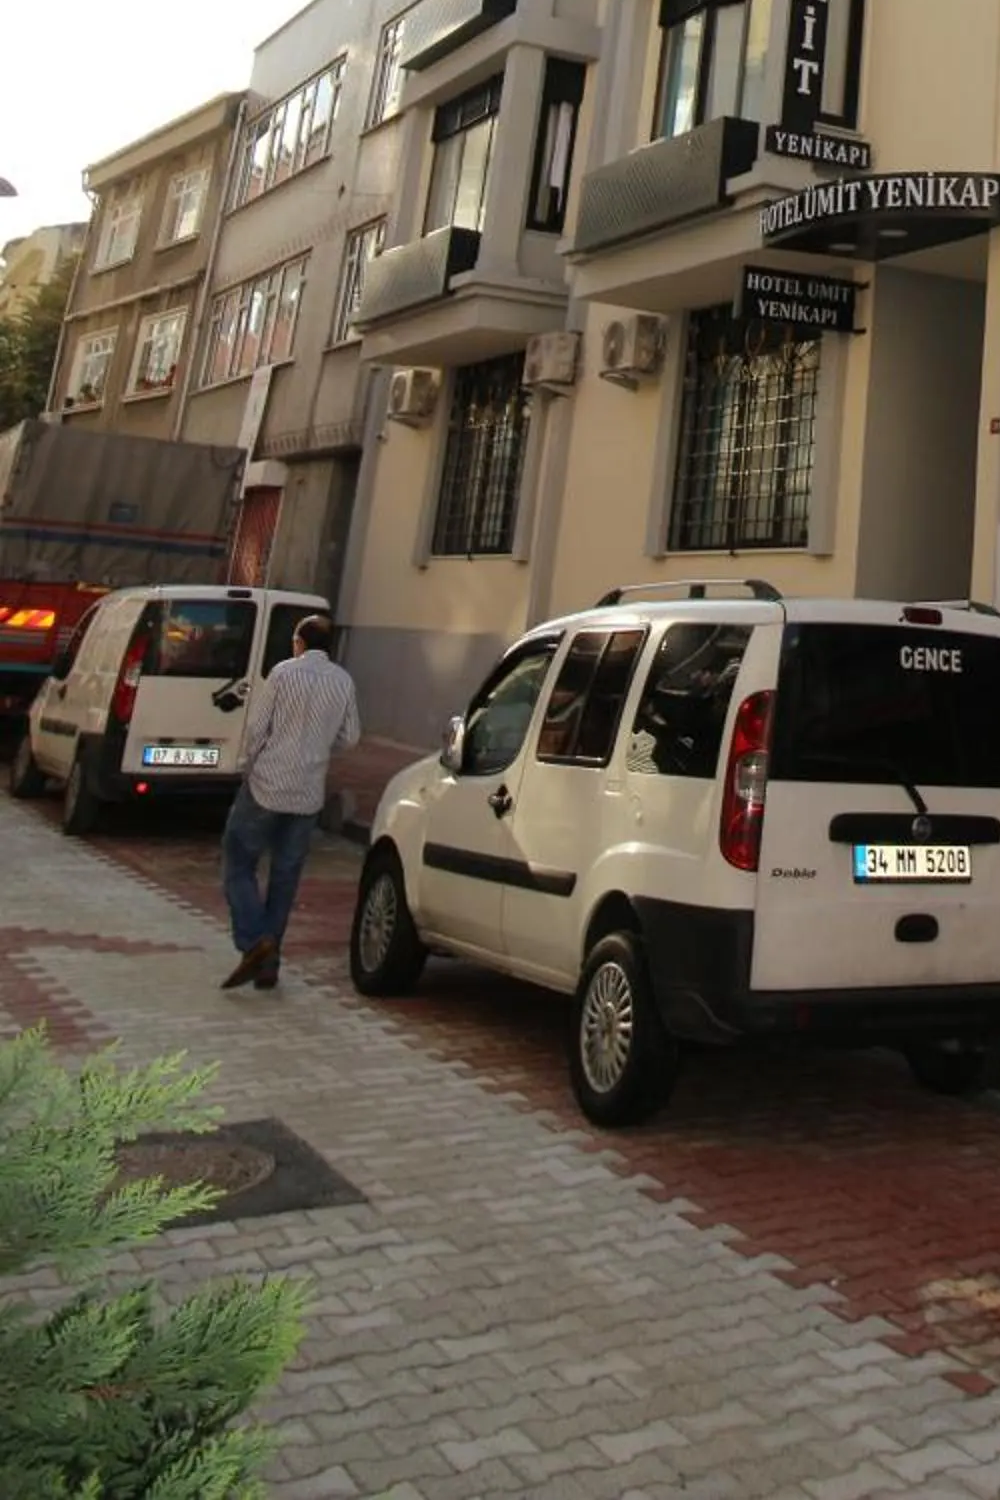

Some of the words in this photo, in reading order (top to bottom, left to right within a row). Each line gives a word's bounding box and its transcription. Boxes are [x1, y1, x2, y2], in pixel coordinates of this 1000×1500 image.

[774, 131, 869, 167] YENİKAPI
[759, 195, 803, 235] HOTEL
[804, 177, 861, 219] ÜMİT
[747, 272, 803, 297] HOTEL
[867, 848, 888, 873] 34
[896, 848, 918, 873] MM
[925, 848, 967, 873] 5208
